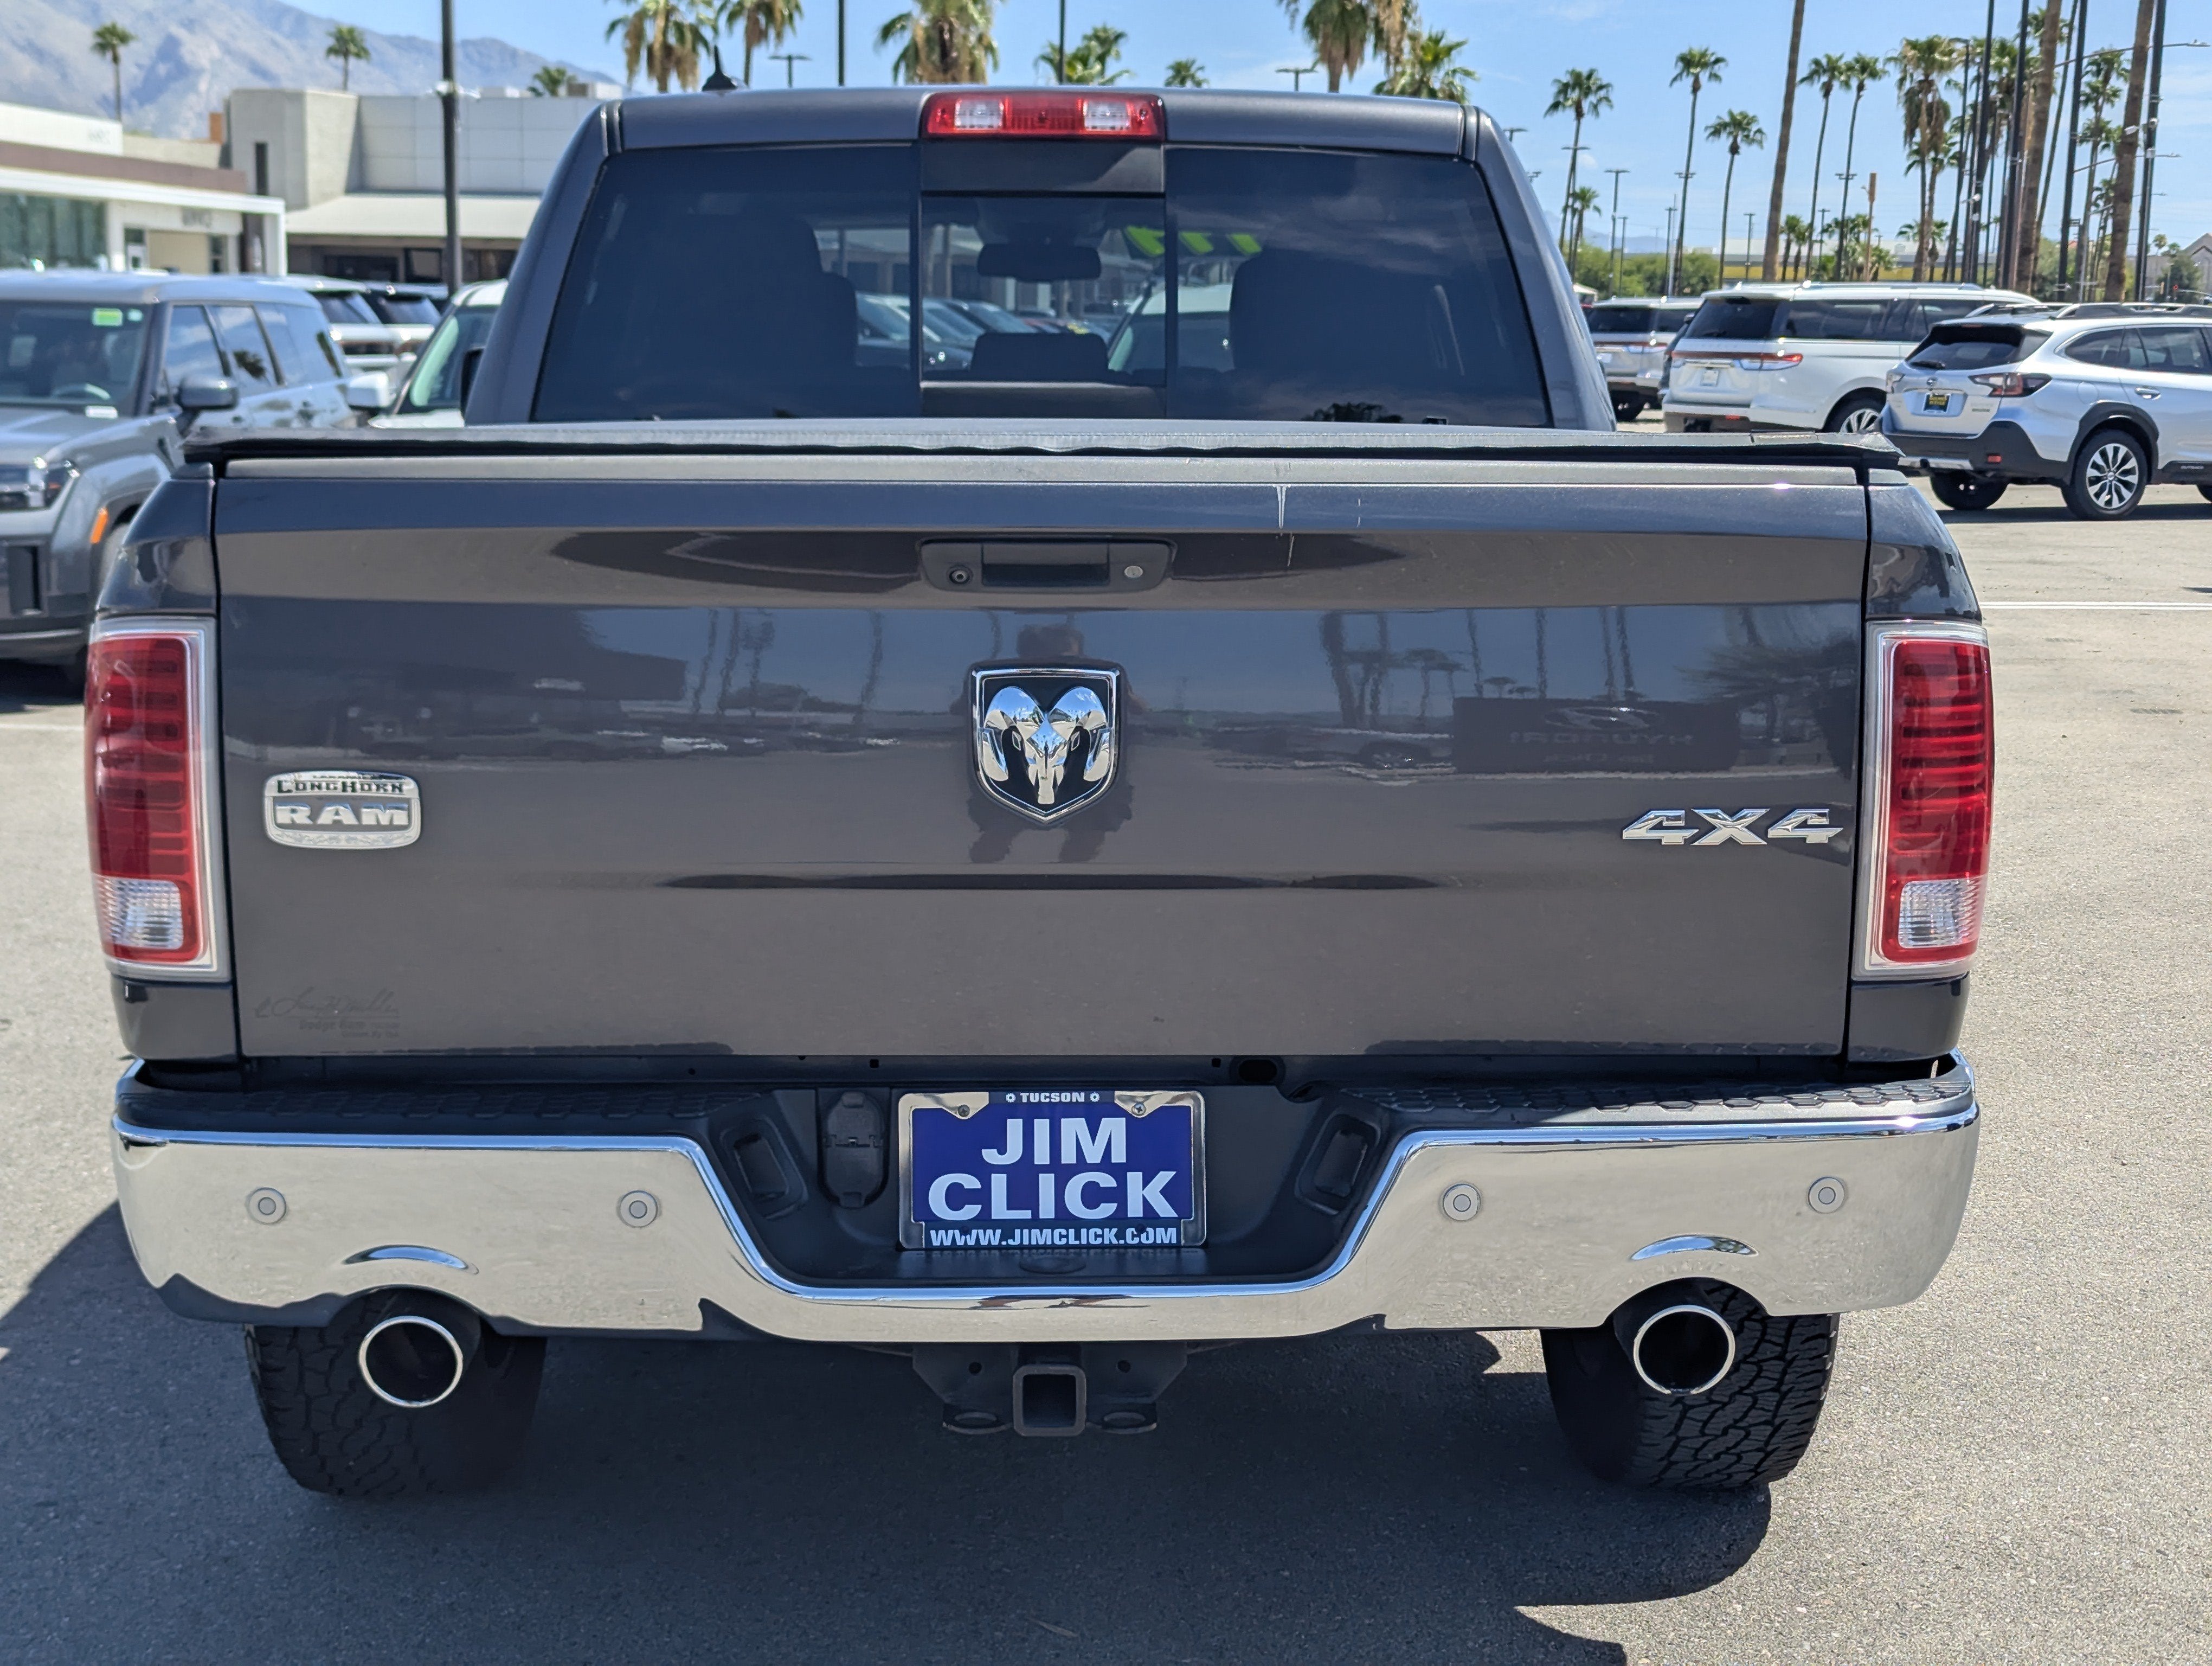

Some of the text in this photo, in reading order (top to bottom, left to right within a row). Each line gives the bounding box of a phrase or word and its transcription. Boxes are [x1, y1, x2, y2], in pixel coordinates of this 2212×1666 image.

[275, 802, 409, 825] RAM
[1020, 1092, 1085, 1103] TUCSON
[981, 1117, 1126, 1164] JIM
[928, 1171, 1178, 1220] CLICK
[930, 1227, 1177, 1246] WWW.JIMCLICK.COM
